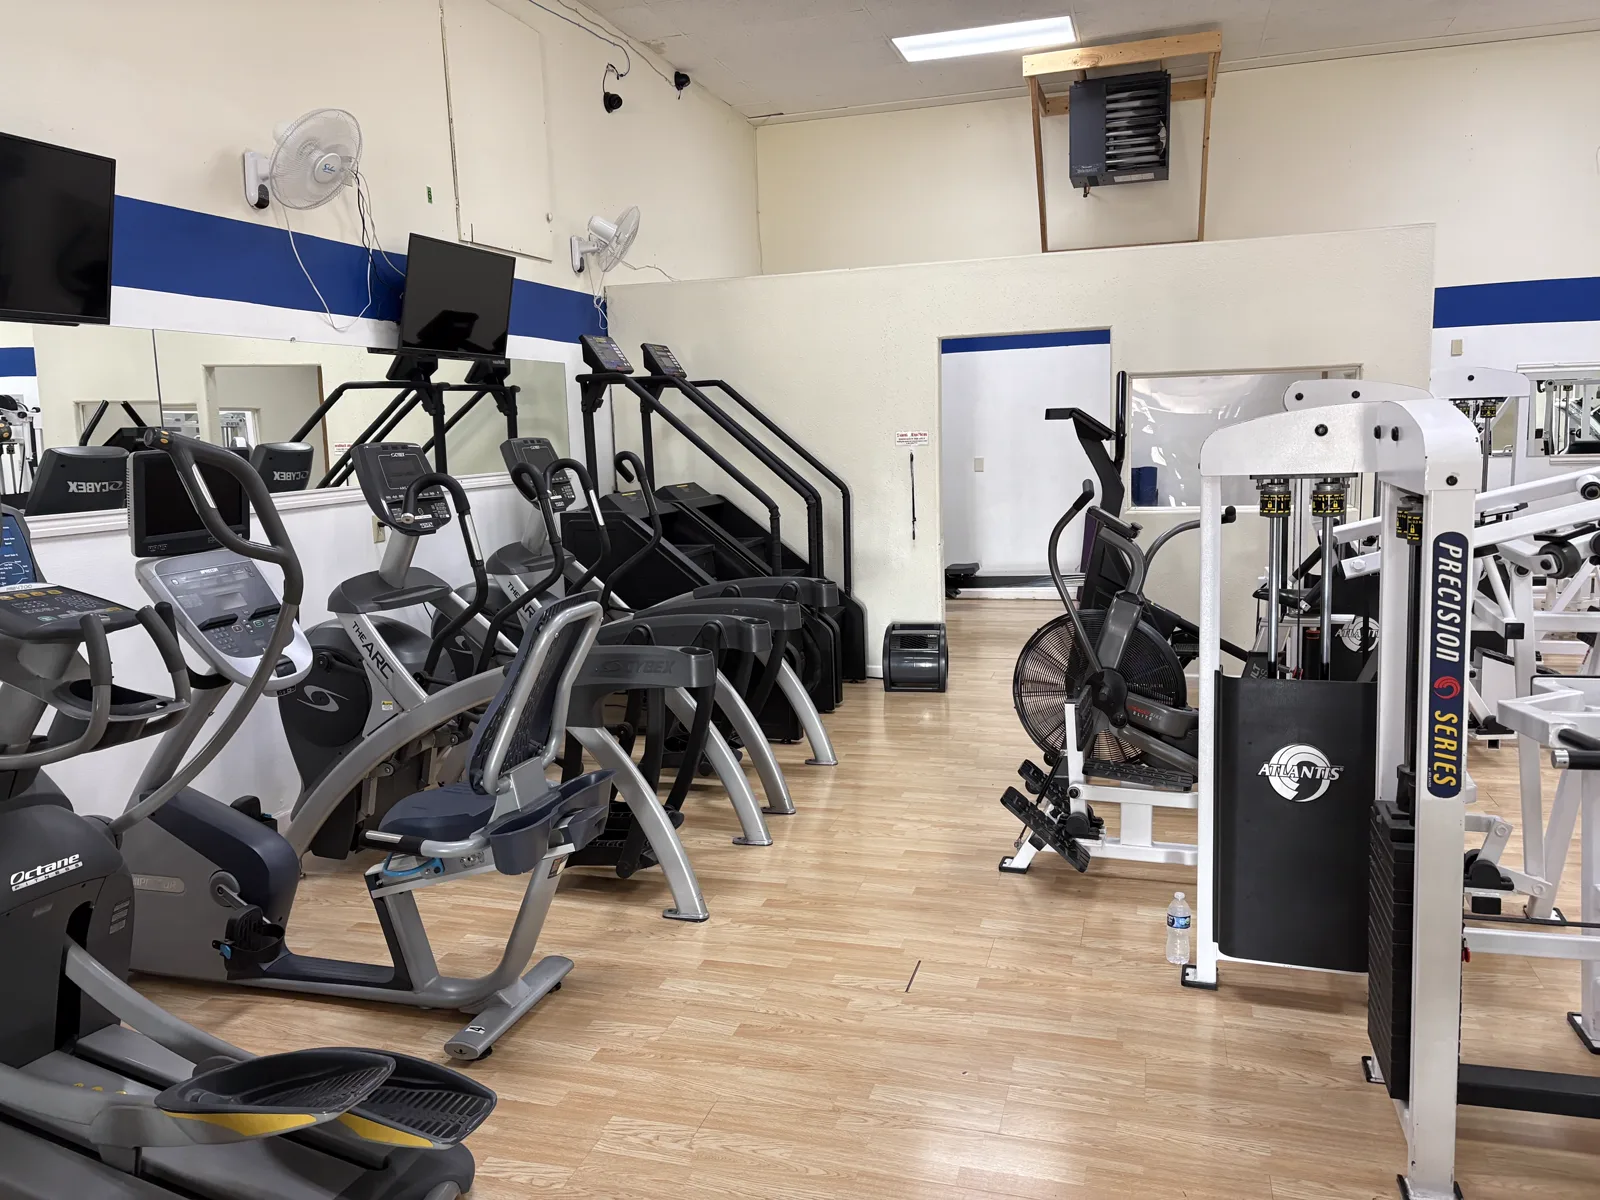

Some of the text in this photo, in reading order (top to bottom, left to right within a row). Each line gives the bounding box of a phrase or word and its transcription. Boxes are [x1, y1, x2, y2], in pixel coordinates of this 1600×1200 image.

[507, 581, 521, 599] THE
[352, 621, 367, 644] THE
[362, 642, 395, 680] ARC
[626, 659, 676, 675] CYBEX
[1432, 541, 1463, 787] PRECISION SERIES
[1257, 763, 1341, 781] ATLANTIS
[10, 853, 80, 886] Octane
